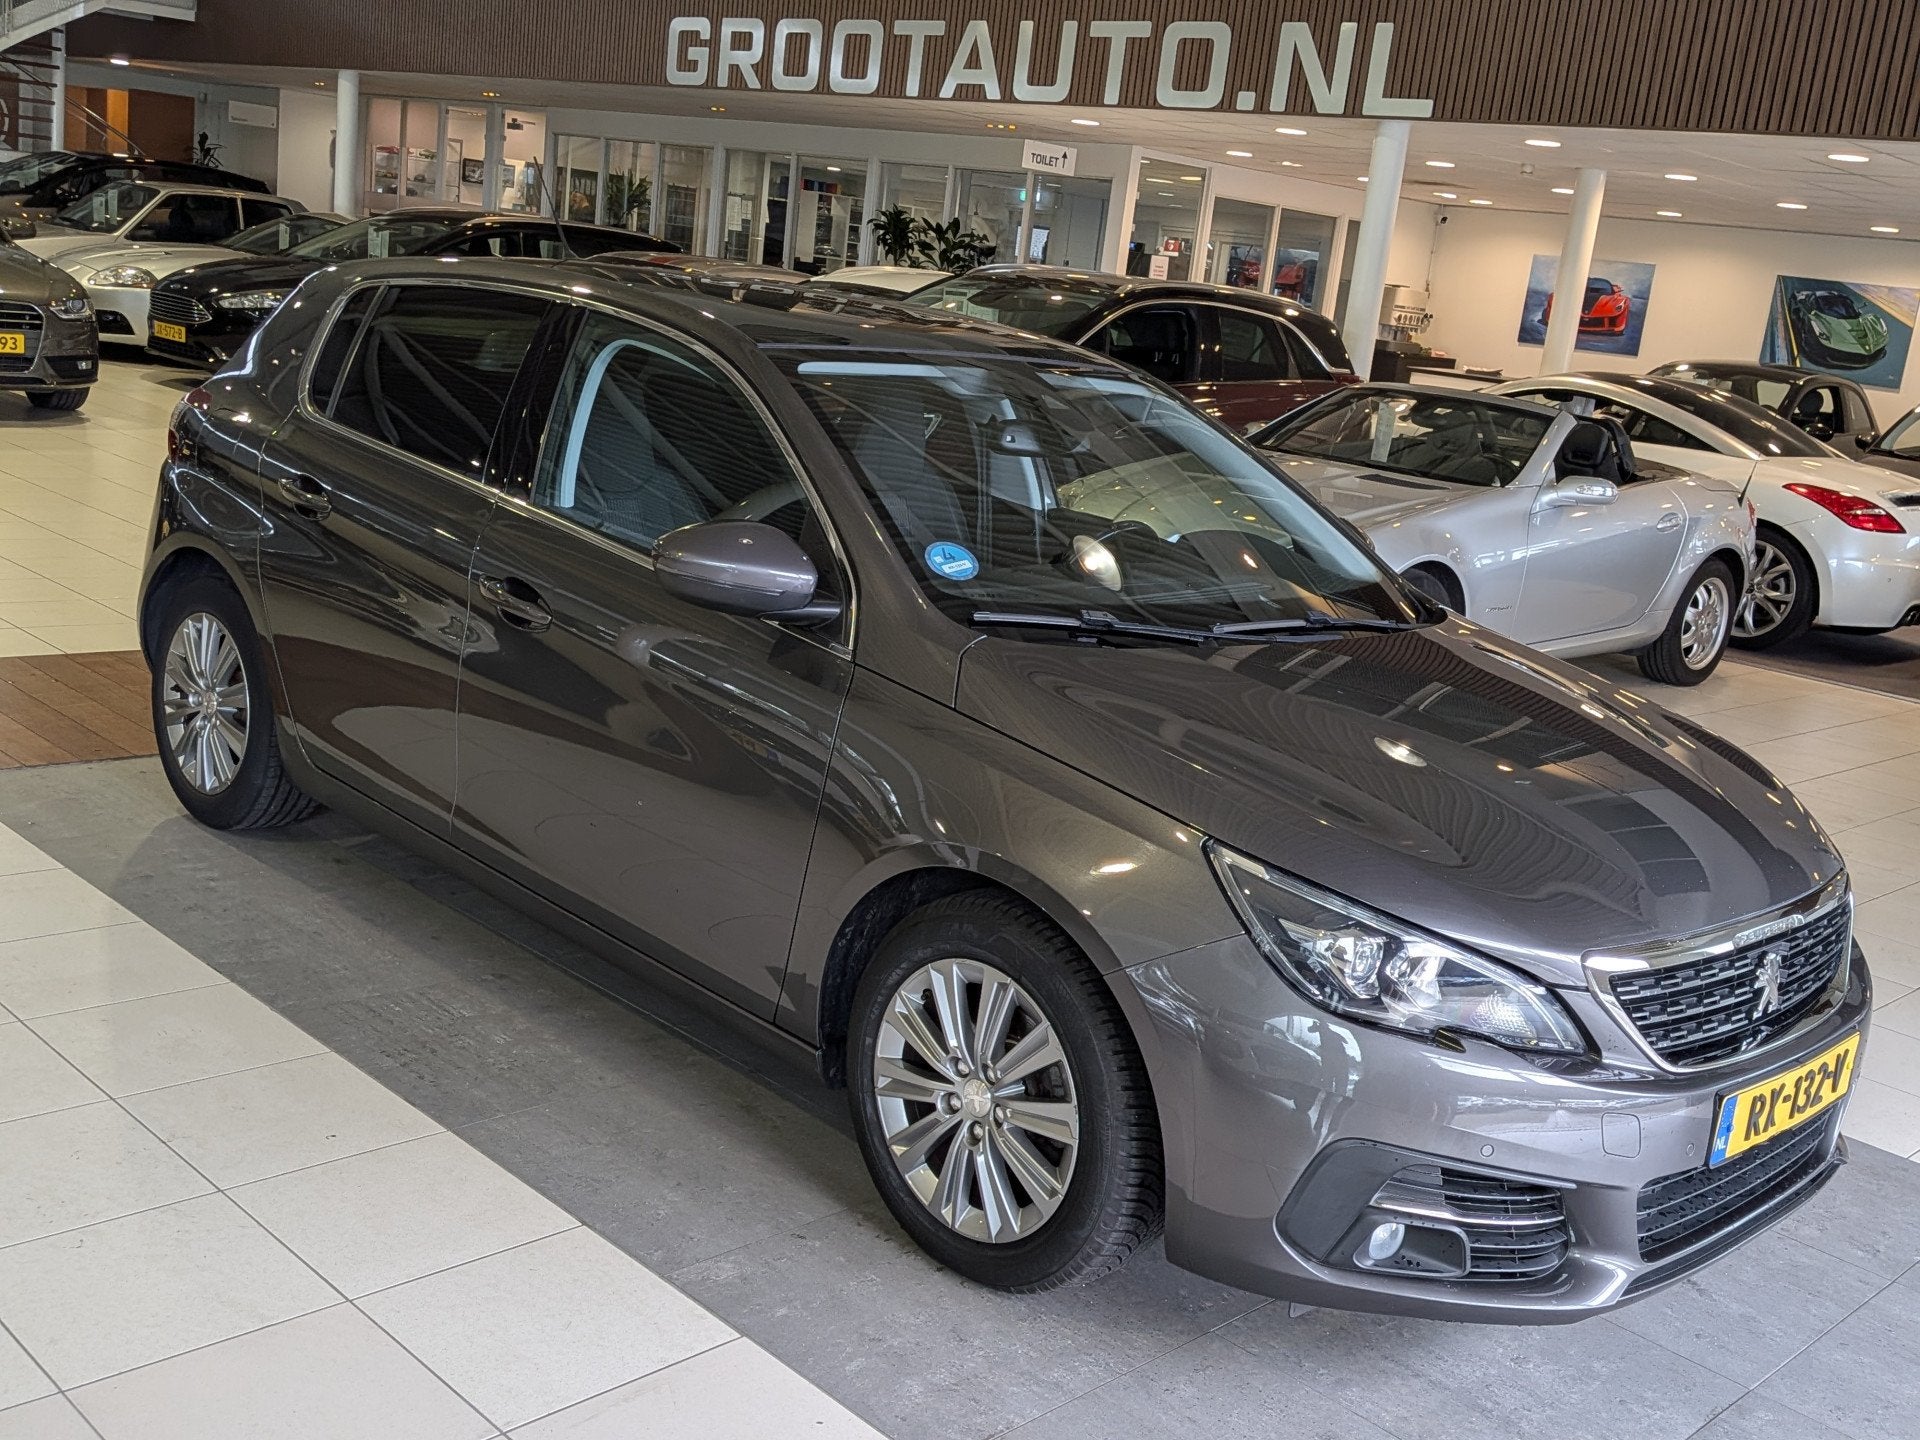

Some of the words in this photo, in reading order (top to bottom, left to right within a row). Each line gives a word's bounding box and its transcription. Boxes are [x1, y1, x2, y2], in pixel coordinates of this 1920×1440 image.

[666, 16, 1434, 119] GROOTAUTO.NL
[1030, 152, 1060, 168] TOILET
[1743, 1048, 1850, 1142] RX-132-V
